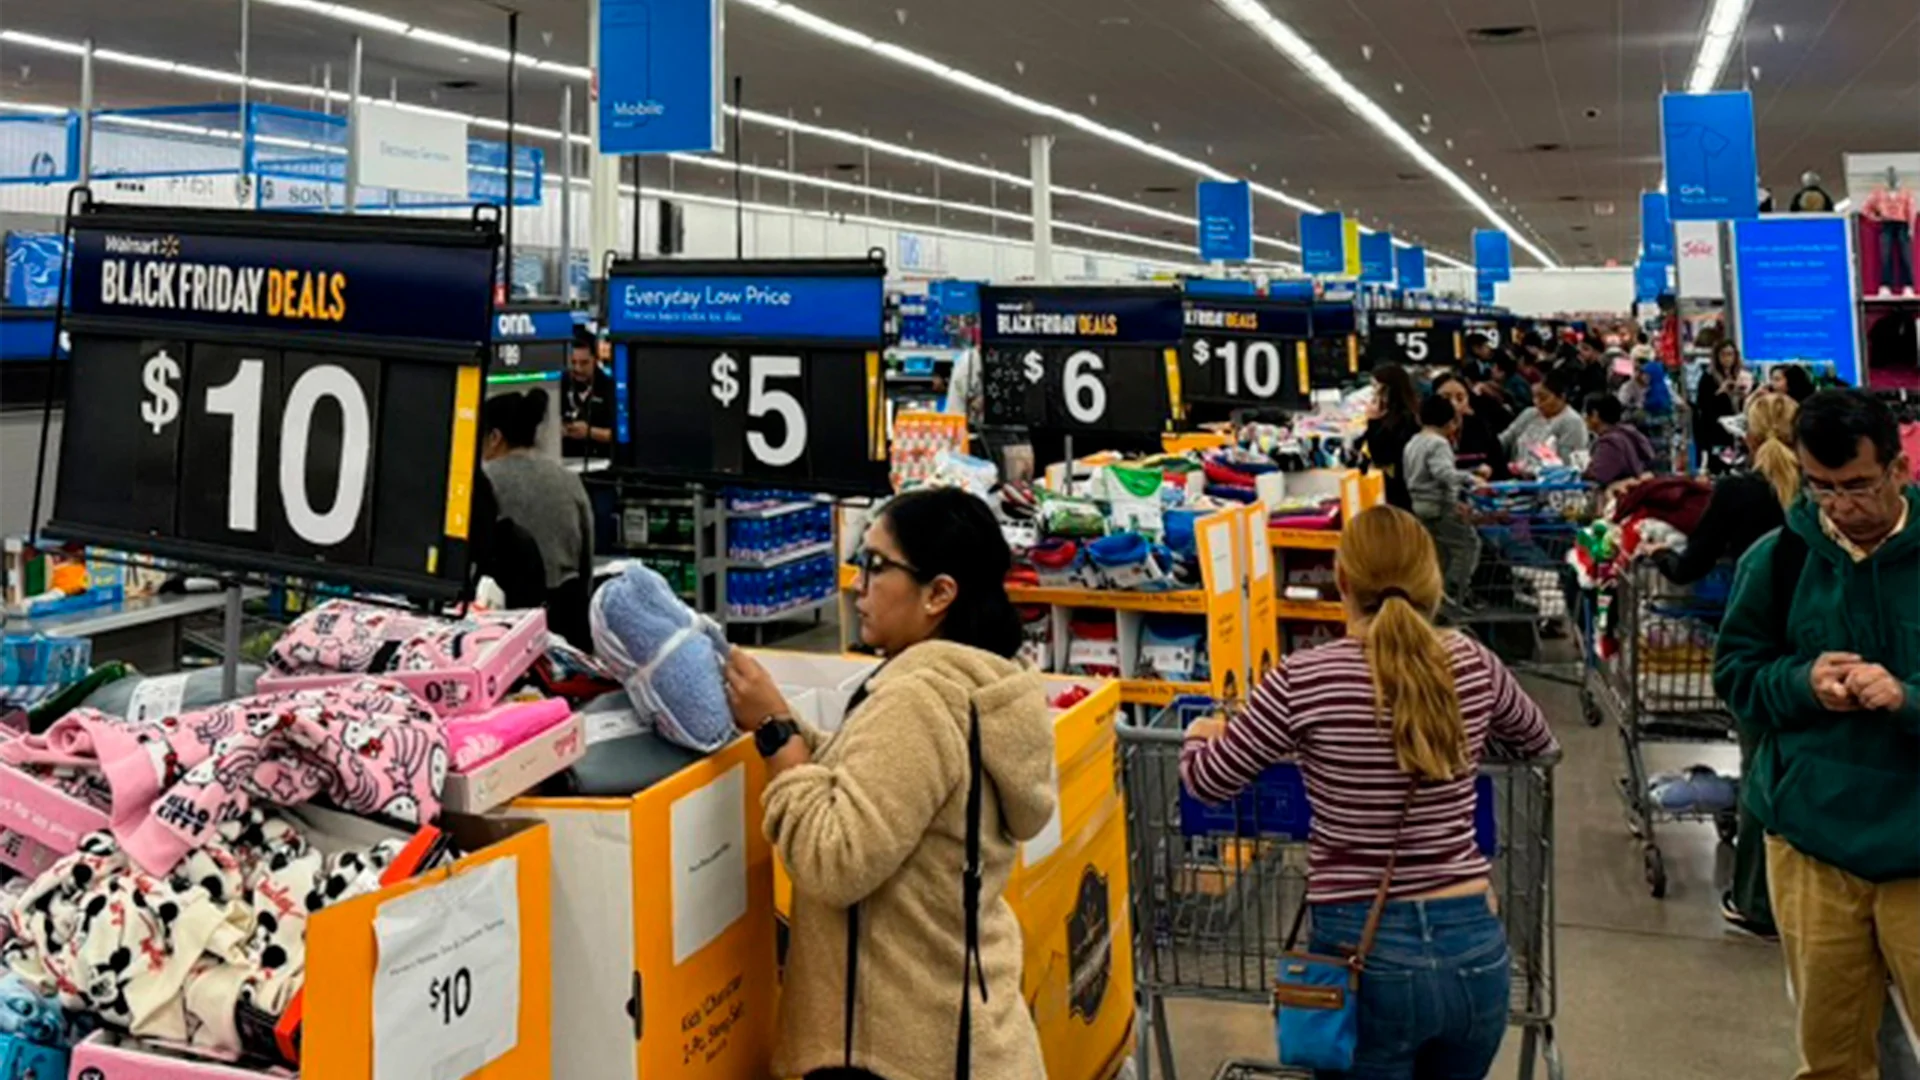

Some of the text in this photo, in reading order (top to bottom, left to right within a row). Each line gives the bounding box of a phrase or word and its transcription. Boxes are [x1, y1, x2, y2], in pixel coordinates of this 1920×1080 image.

[105, 235, 160, 255] Walmart
[101, 259, 346, 321] BLACK FRIDAY DEALS
[625, 284, 792, 309] Everyday Low Price
[997, 313, 1118, 335] BLACK FRIDAY DEALS
[1395, 331, 1429, 361] $5
[1023, 349, 1107, 424] $6
[1192, 338, 1281, 398] $10
[711, 353, 807, 466] $5
[140, 350, 371, 546] $10
[429, 966, 472, 1025] $10
